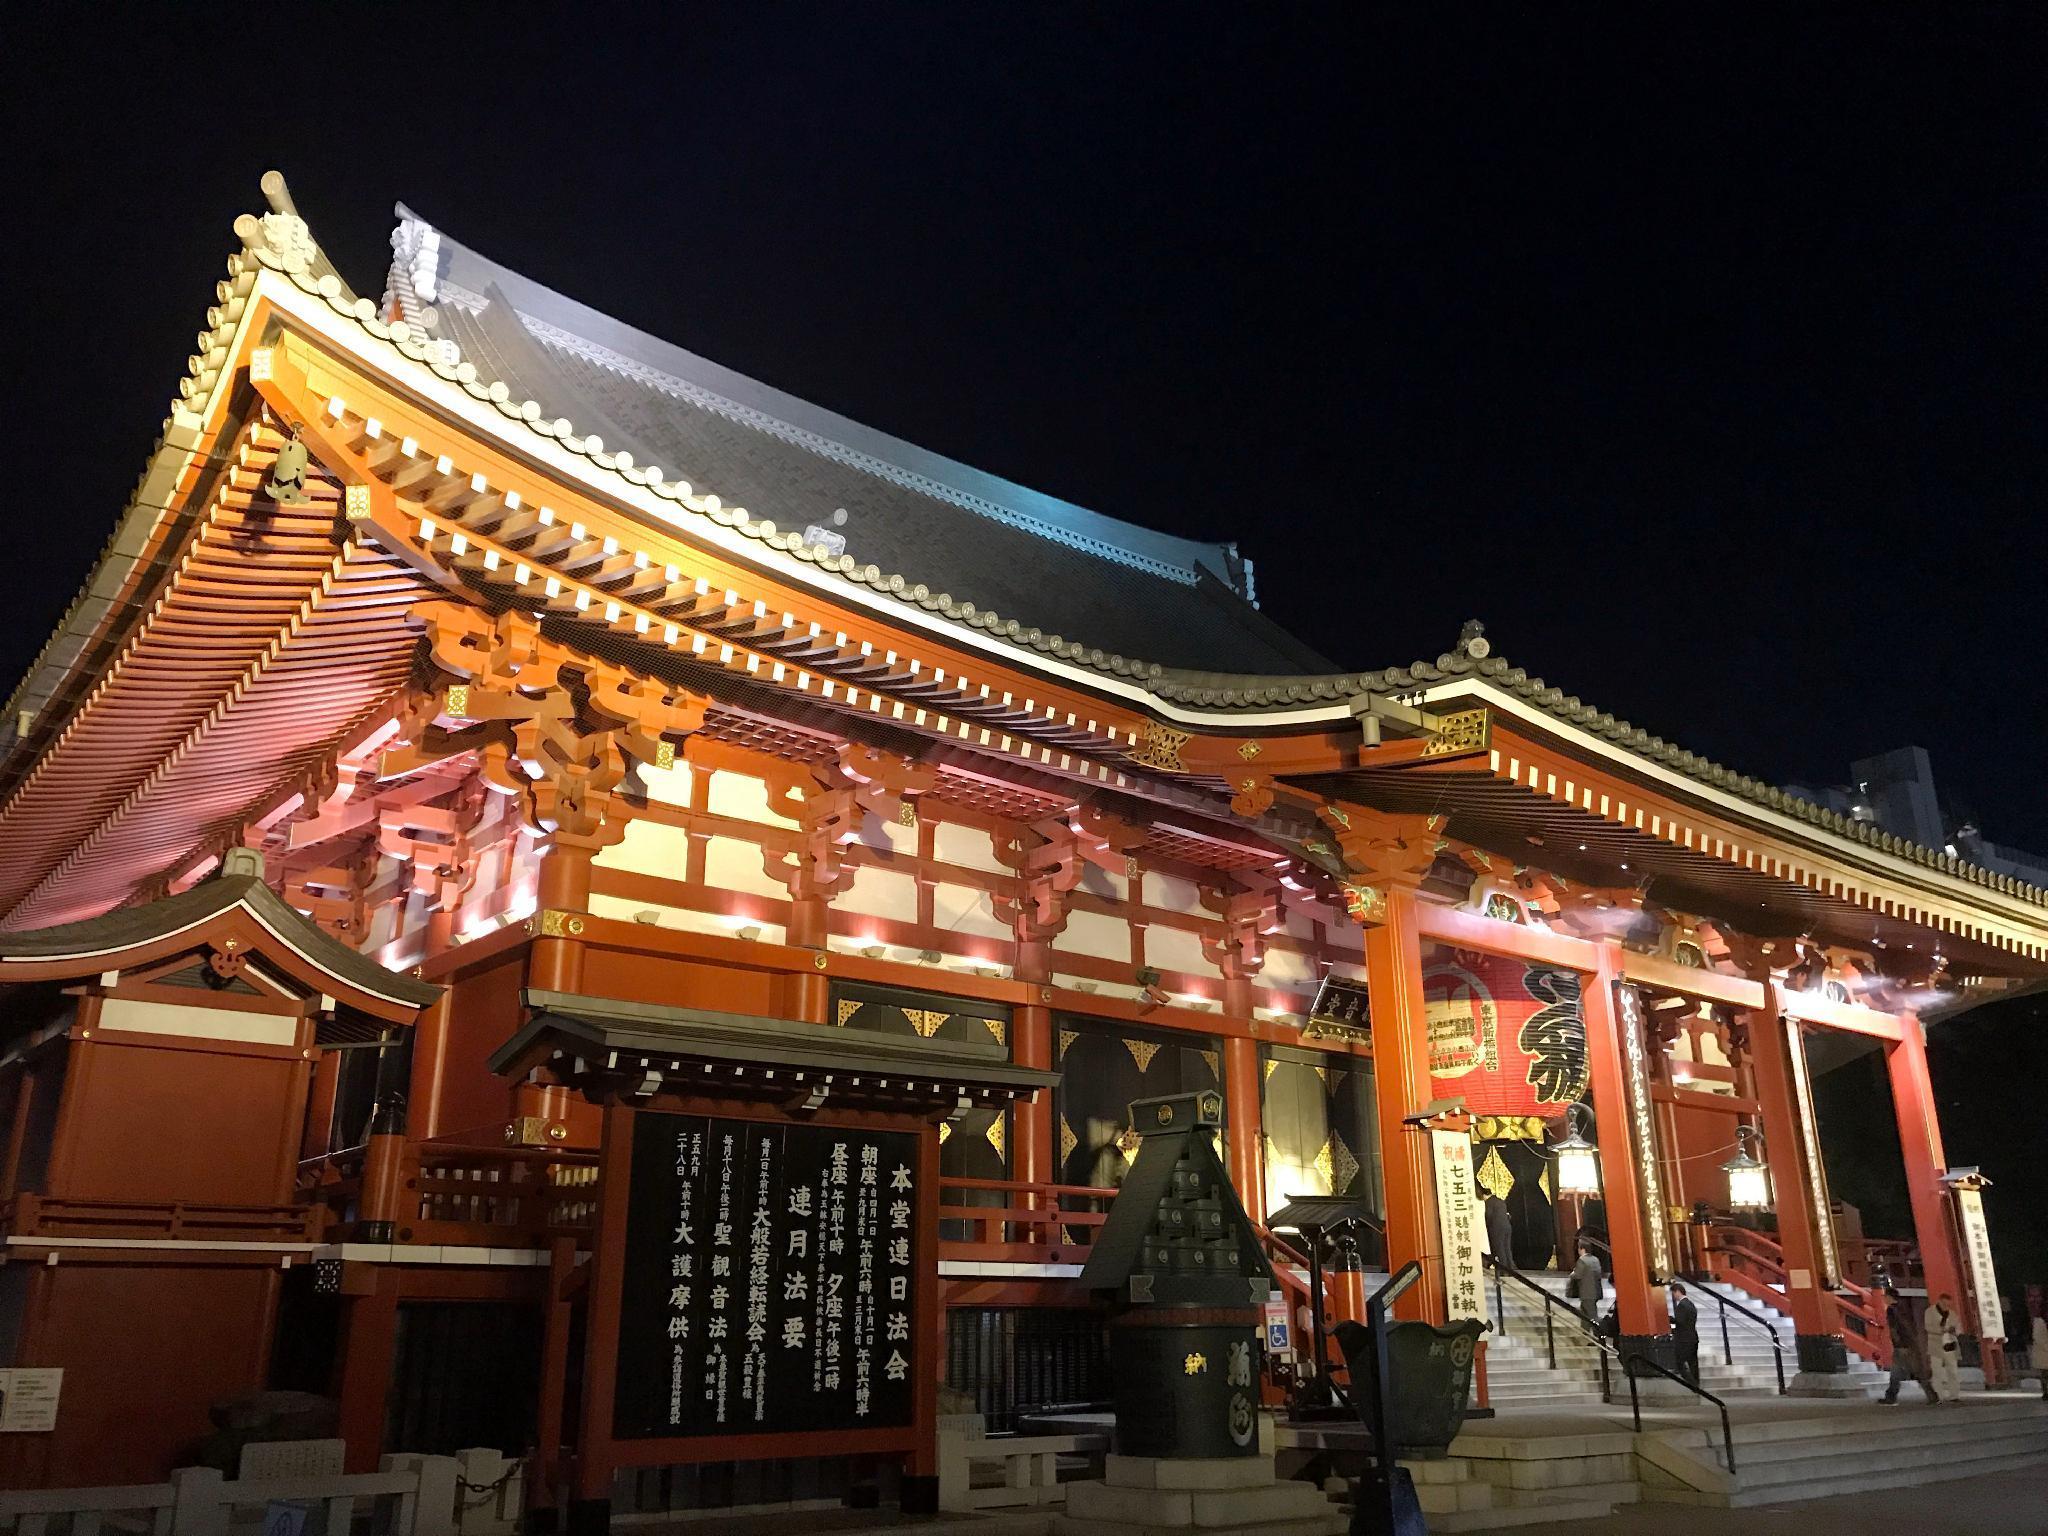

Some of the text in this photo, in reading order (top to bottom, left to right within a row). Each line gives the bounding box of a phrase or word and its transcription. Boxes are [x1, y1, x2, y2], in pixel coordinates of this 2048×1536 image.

[1480, 1003, 1498, 1072] 東京新橋組合
[676, 1133, 688, 1176] 二十八日
[690, 1133, 702, 1177] 正五九月
[860, 1144, 878, 1185] 朝座
[1450, 1165, 1468, 1212] 七五三
[869, 1188, 877, 1236] 自四月一日
[667, 1222, 695, 1339] 大護摩供
[708, 1222, 733, 1338] 聖観音法
[746, 1207, 772, 1342] 大般若経転読会
[781, 1187, 812, 1349] 連月法要
[858, 1239, 873, 1294] 午前六時
[884, 1163, 913, 1380] 本堂連日法会
[1456, 1245, 1479, 1320] 御加持執
[866, 1296, 875, 1345] 自十月一日
[856, 1348, 871, 1417] 午前六時半
